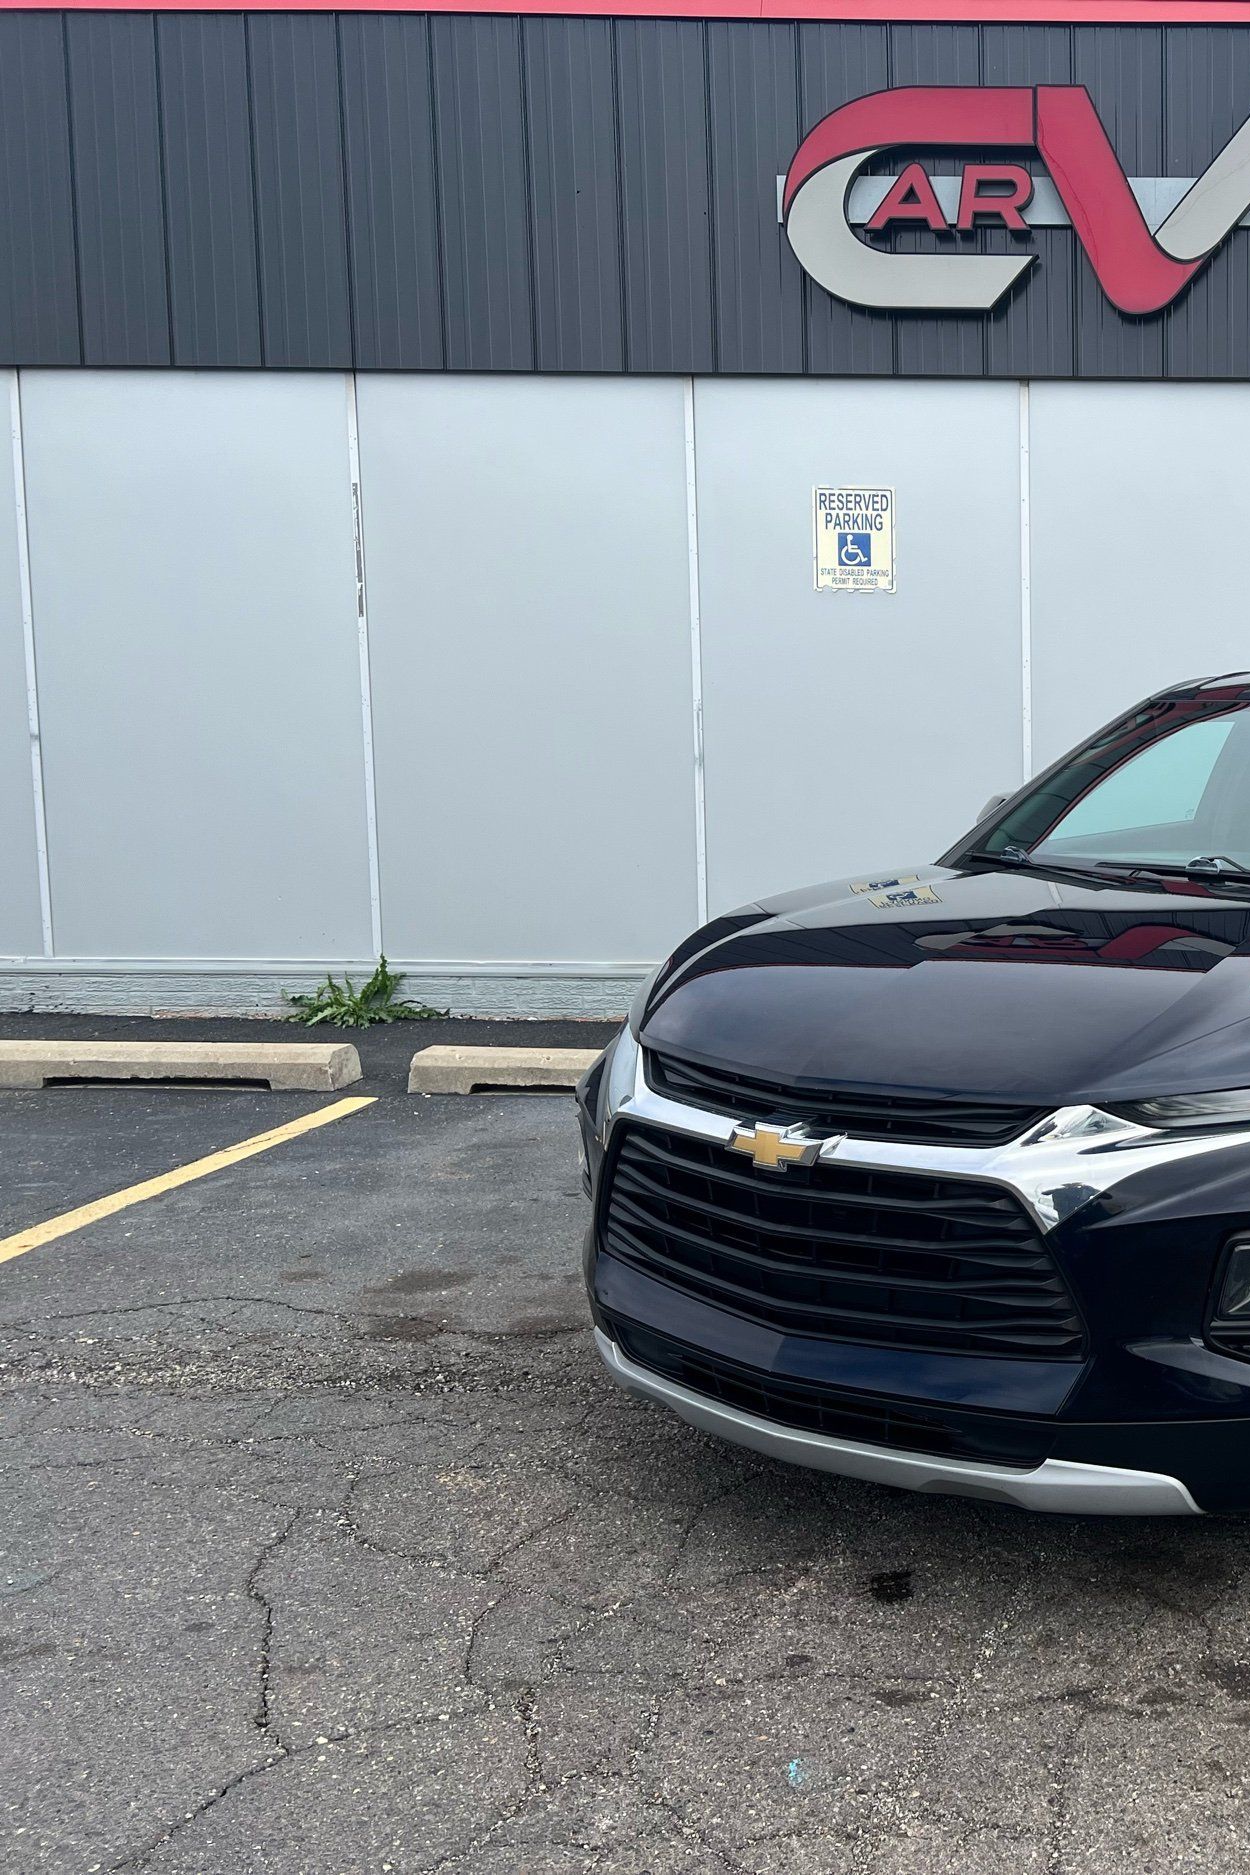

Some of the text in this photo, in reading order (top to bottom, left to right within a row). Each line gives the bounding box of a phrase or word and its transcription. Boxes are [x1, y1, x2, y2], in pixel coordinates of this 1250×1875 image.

[819, 492, 889, 511] RESERVED
[825, 513, 884, 531] PARKING
[820, 567, 890, 577] STATE DISABLED PARKING
[832, 577, 879, 586] PERMIT REQUIRED
